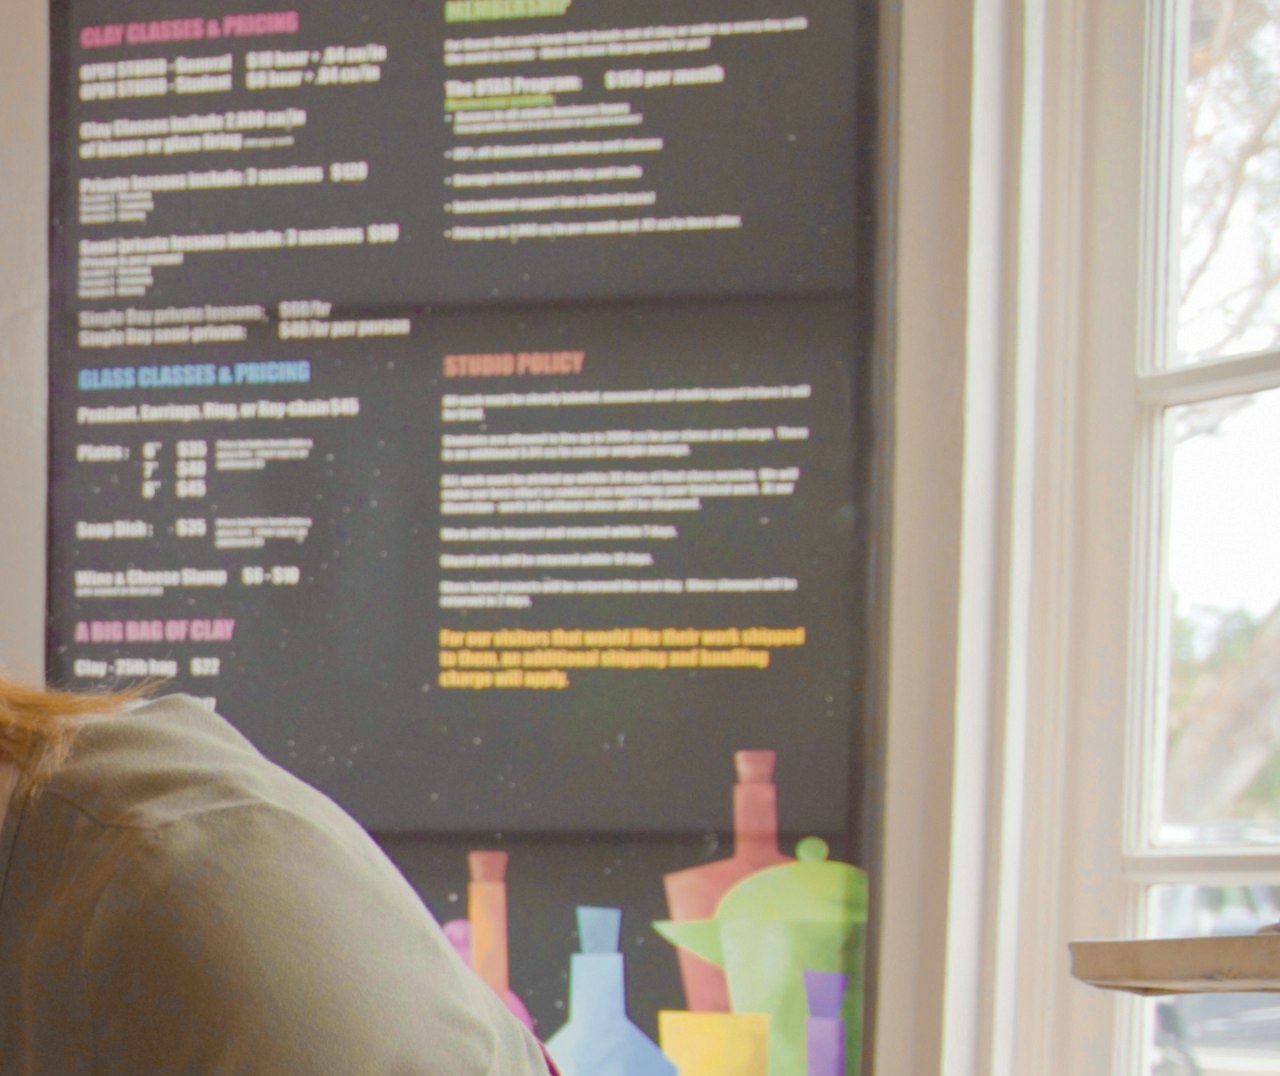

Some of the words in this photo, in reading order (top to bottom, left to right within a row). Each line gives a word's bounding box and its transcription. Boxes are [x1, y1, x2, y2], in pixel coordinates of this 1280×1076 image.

[80, 24, 123, 48] CLAY
[125, 18, 204, 45] CLASSES
[223, 11, 299, 38] PRICING
[78, 367, 135, 390] GLASS
[137, 364, 216, 388] CLASSES
[234, 360, 311, 385] PRICING
[443, 352, 515, 378] STUDIO
[516, 350, 586, 376] POLICY
[90, 620, 123, 643] BIG
[125, 619, 163, 642] BAG
[164, 619, 189, 642] OF
[190, 618, 235, 642] CLAY
